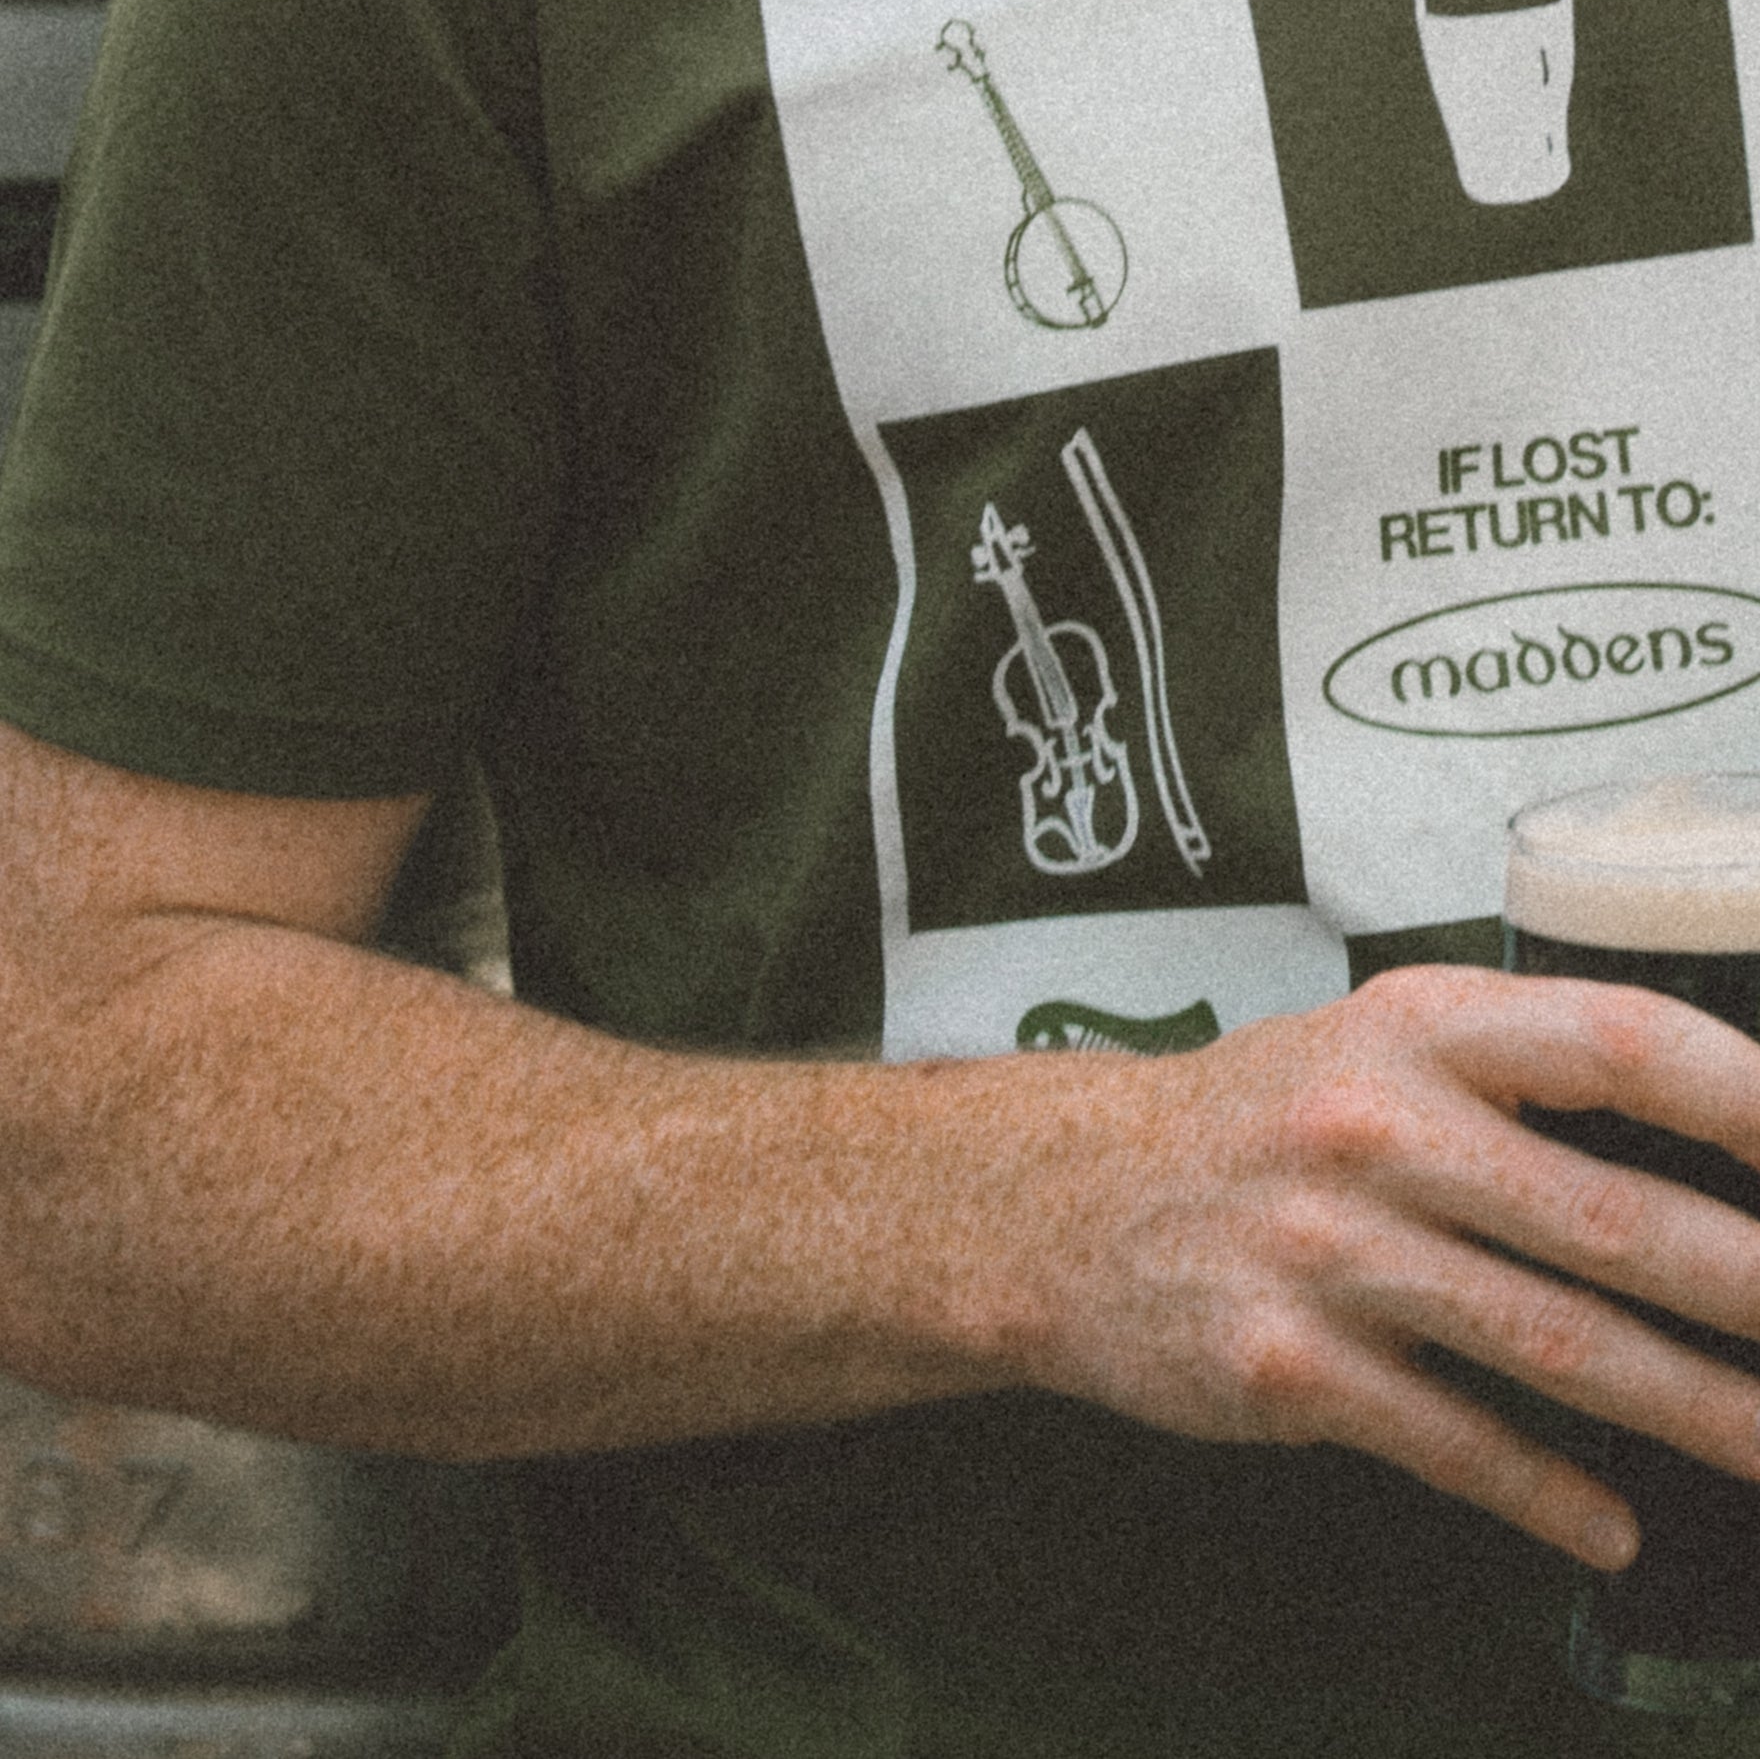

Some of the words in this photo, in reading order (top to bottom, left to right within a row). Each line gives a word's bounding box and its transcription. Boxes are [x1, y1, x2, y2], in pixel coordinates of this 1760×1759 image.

[1437, 444, 1483, 494] IF
[1491, 426, 1640, 487] LOST
[1379, 491, 1609, 562] RETURN
[1616, 480, 1716, 533] TO:
[1390, 622, 1735, 704] maddens
